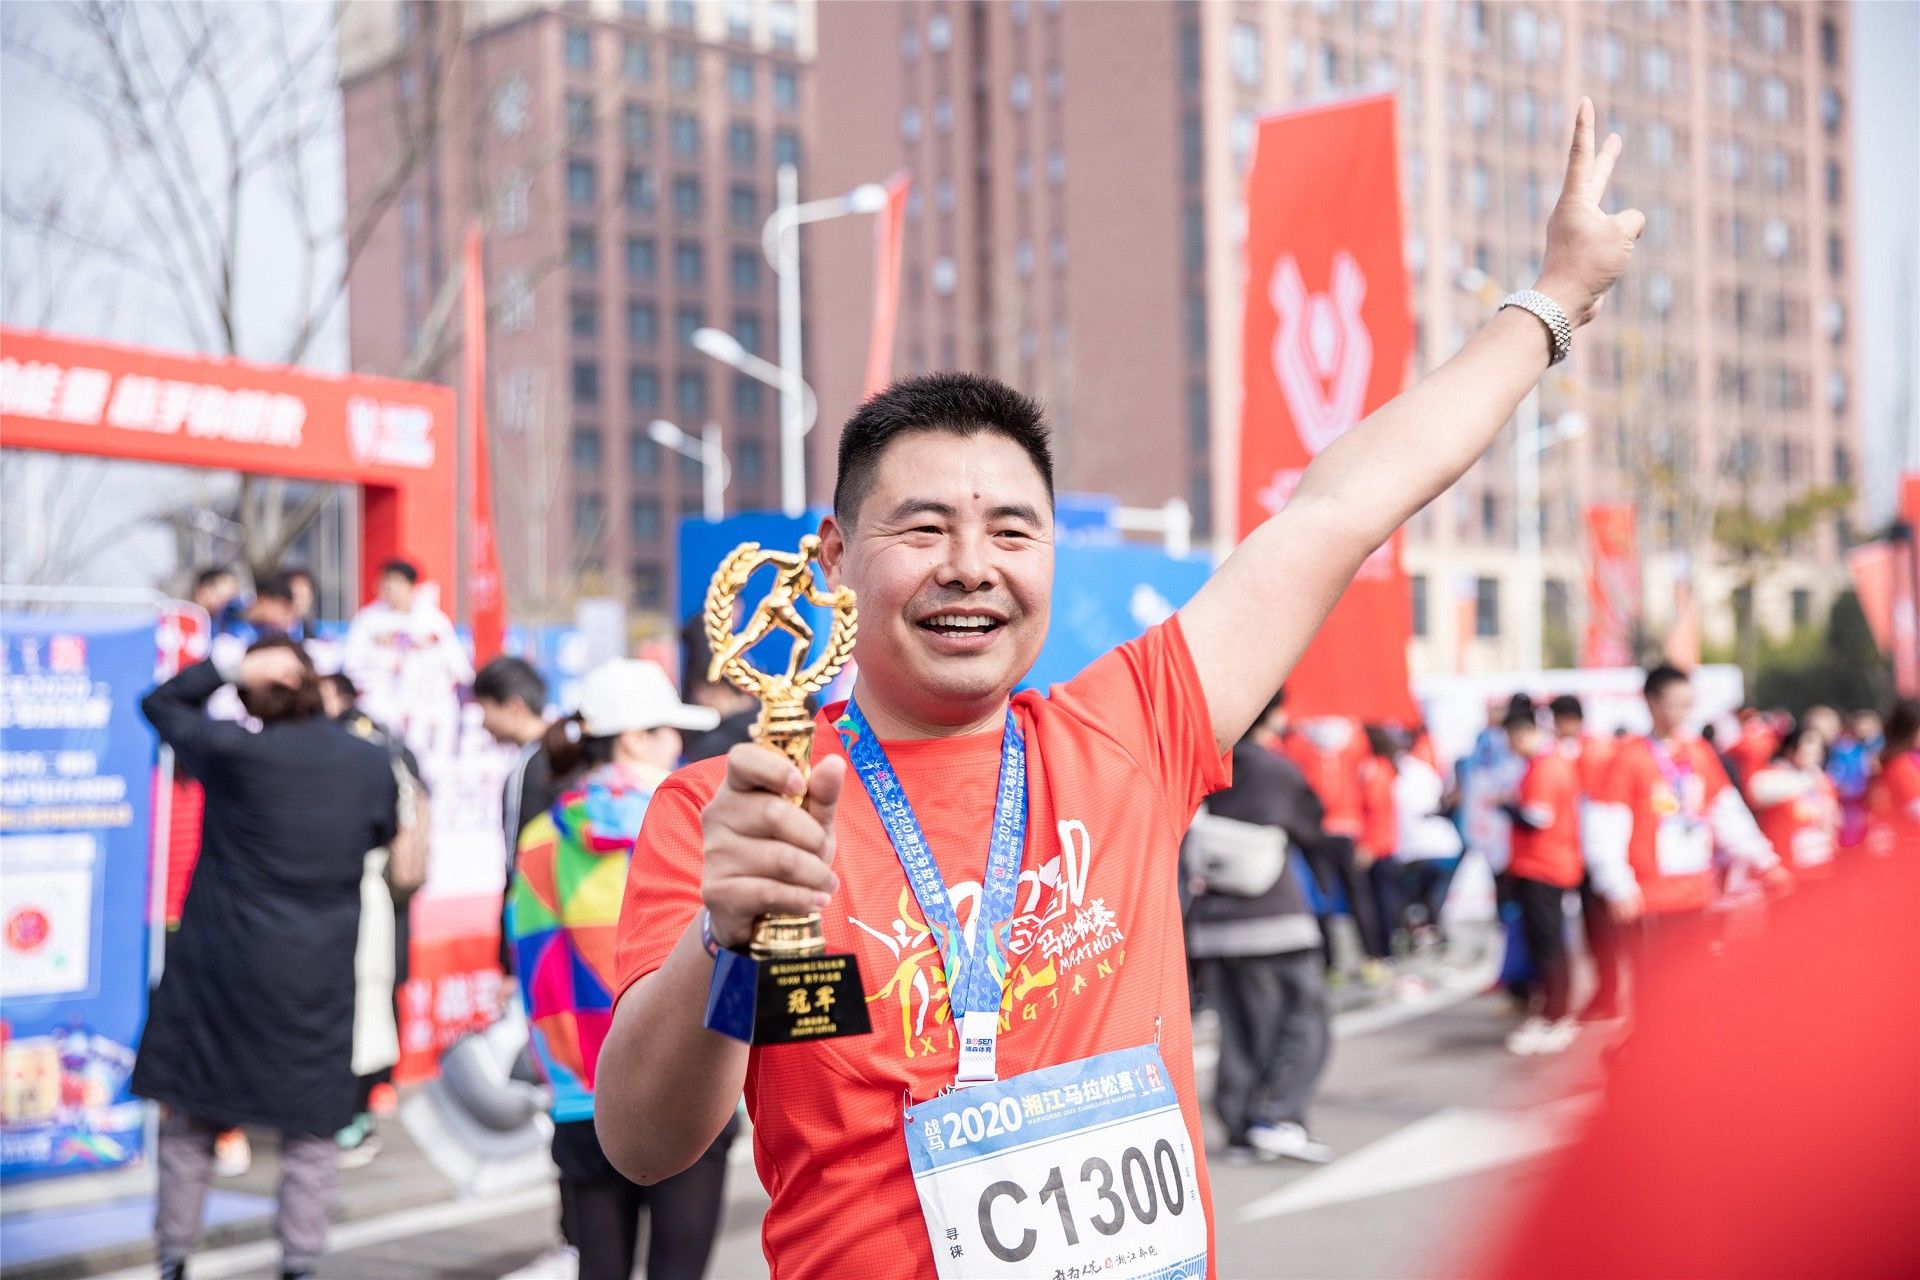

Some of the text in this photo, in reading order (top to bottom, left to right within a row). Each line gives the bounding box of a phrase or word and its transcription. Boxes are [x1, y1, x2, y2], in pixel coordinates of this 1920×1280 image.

[908, 860, 933, 906] MARATHON
[787, 985, 836, 1014] 冠军
[977, 1138, 1185, 1263] C1300
